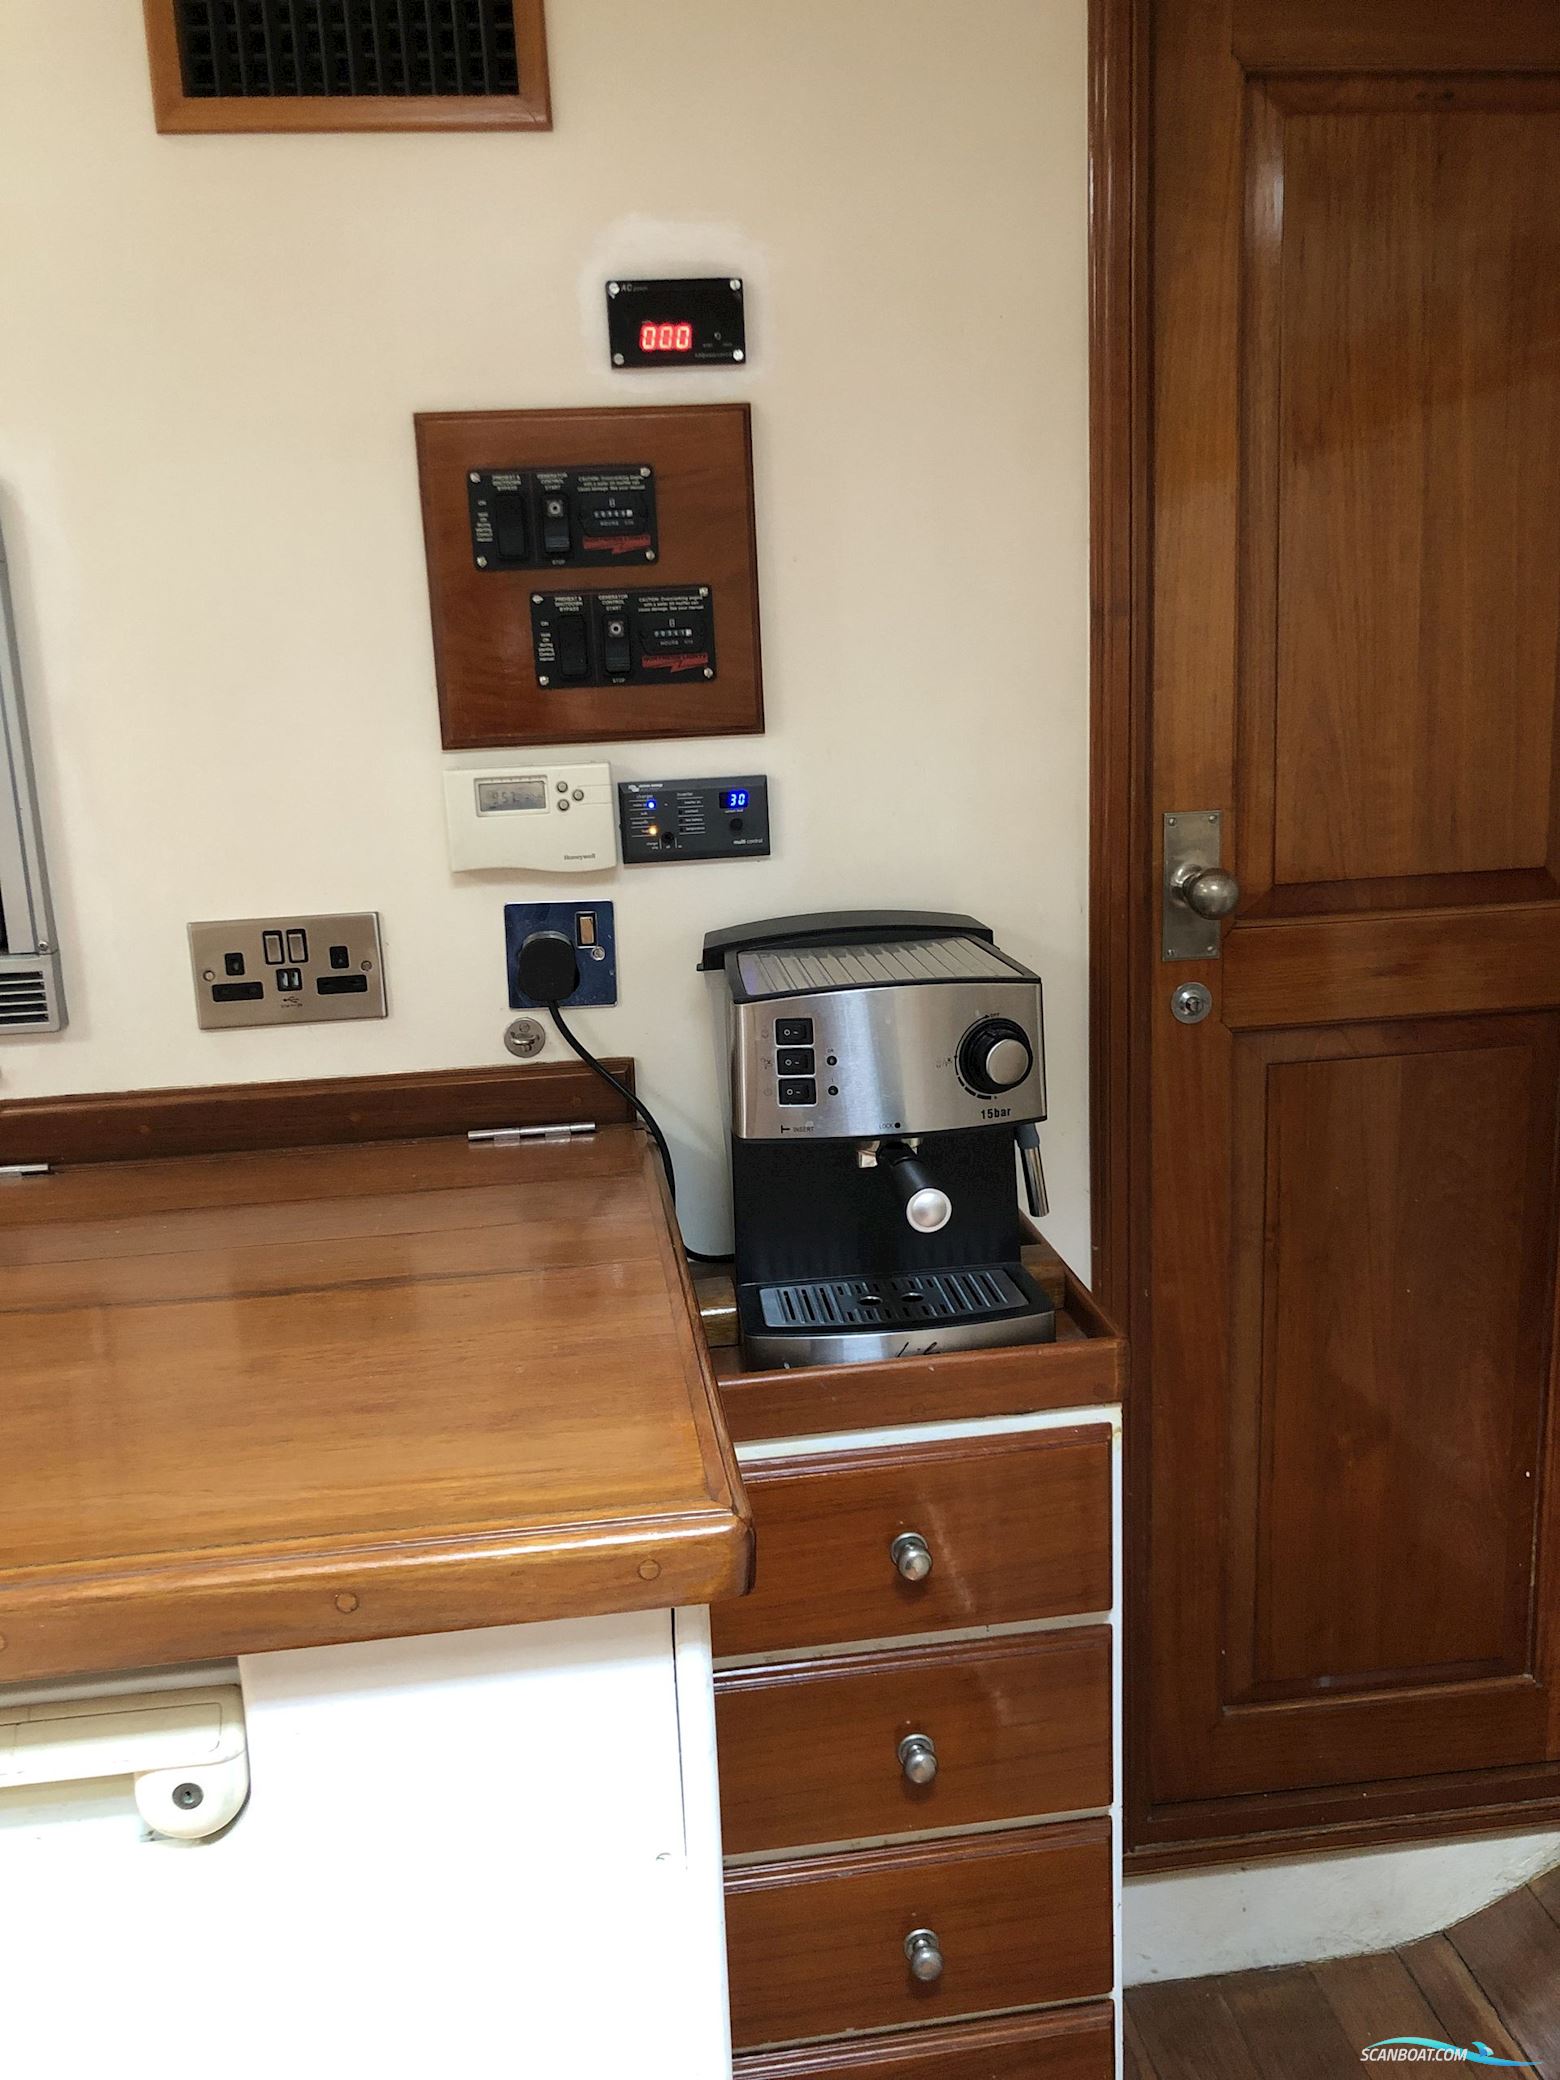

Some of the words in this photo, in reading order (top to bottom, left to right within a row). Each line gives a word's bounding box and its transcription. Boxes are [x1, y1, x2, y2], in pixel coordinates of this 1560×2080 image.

[640, 325, 691, 351] 000
[730, 793, 746, 807] 30
[563, 853, 596, 861] Honeywell
[980, 1107, 1012, 1120] 15bar
